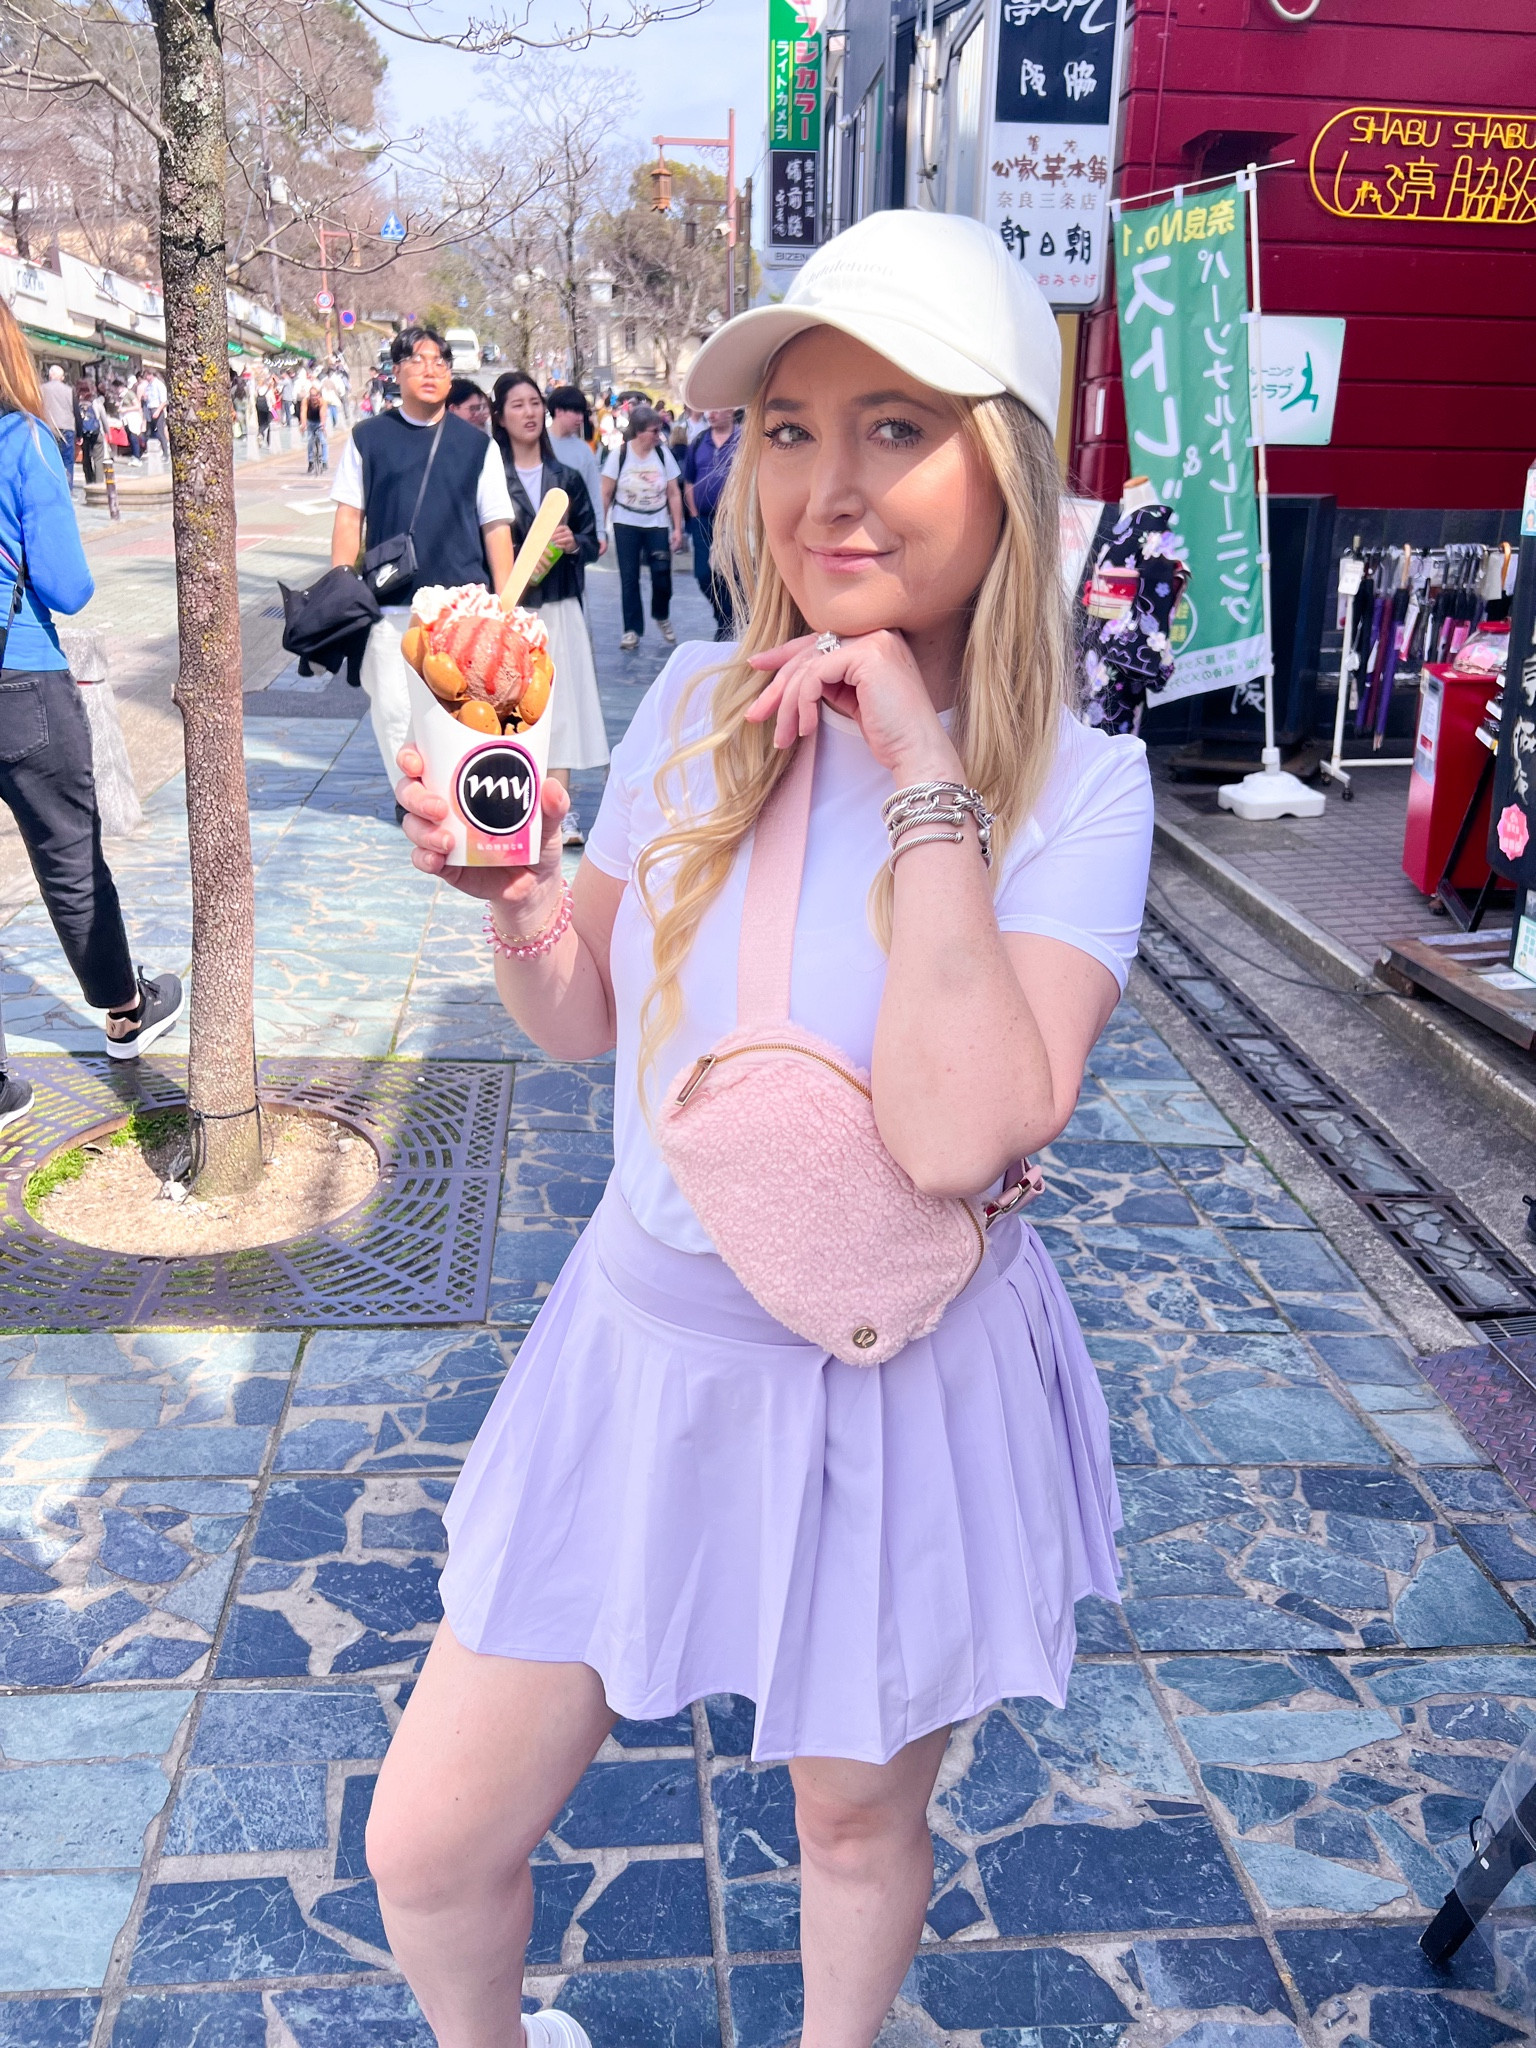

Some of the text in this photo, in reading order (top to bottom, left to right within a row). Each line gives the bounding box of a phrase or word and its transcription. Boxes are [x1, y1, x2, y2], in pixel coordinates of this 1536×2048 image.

[776, 40, 789, 140] ライトカメラ
[794, 16, 819, 141] フジカラー
[1350, 112, 1536, 150] SHABU SHABU
[997, 191, 1097, 210] 奈良三条店
[467, 774, 530, 811] my
